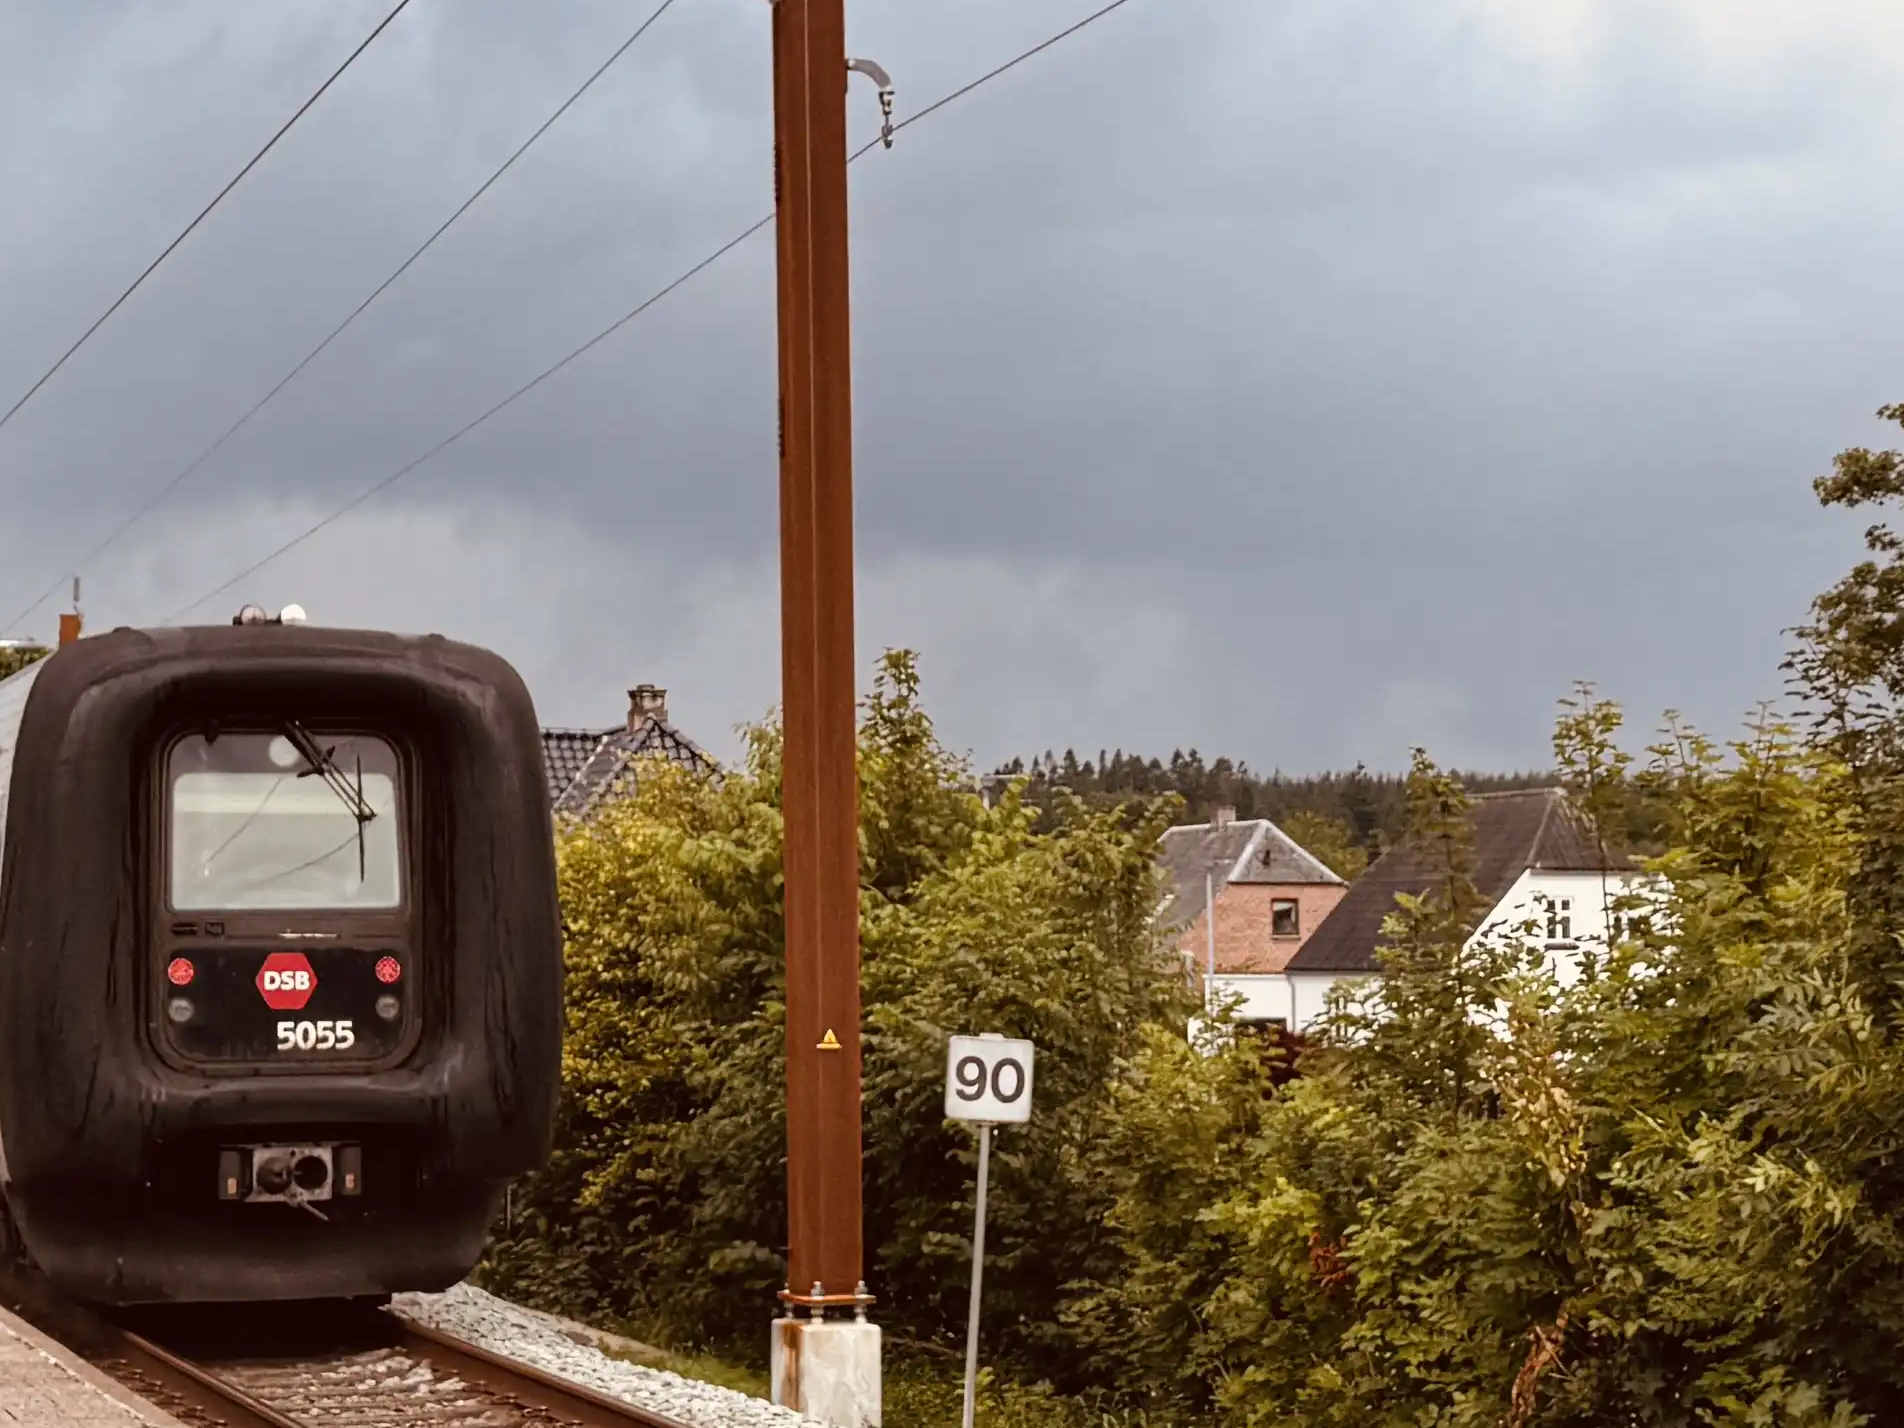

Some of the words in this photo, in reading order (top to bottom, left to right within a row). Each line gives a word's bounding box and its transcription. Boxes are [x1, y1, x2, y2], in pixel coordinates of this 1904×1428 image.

[263, 971, 310, 991] DSB
[277, 1021, 355, 1050] 5055
[955, 1055, 1026, 1104] 90
